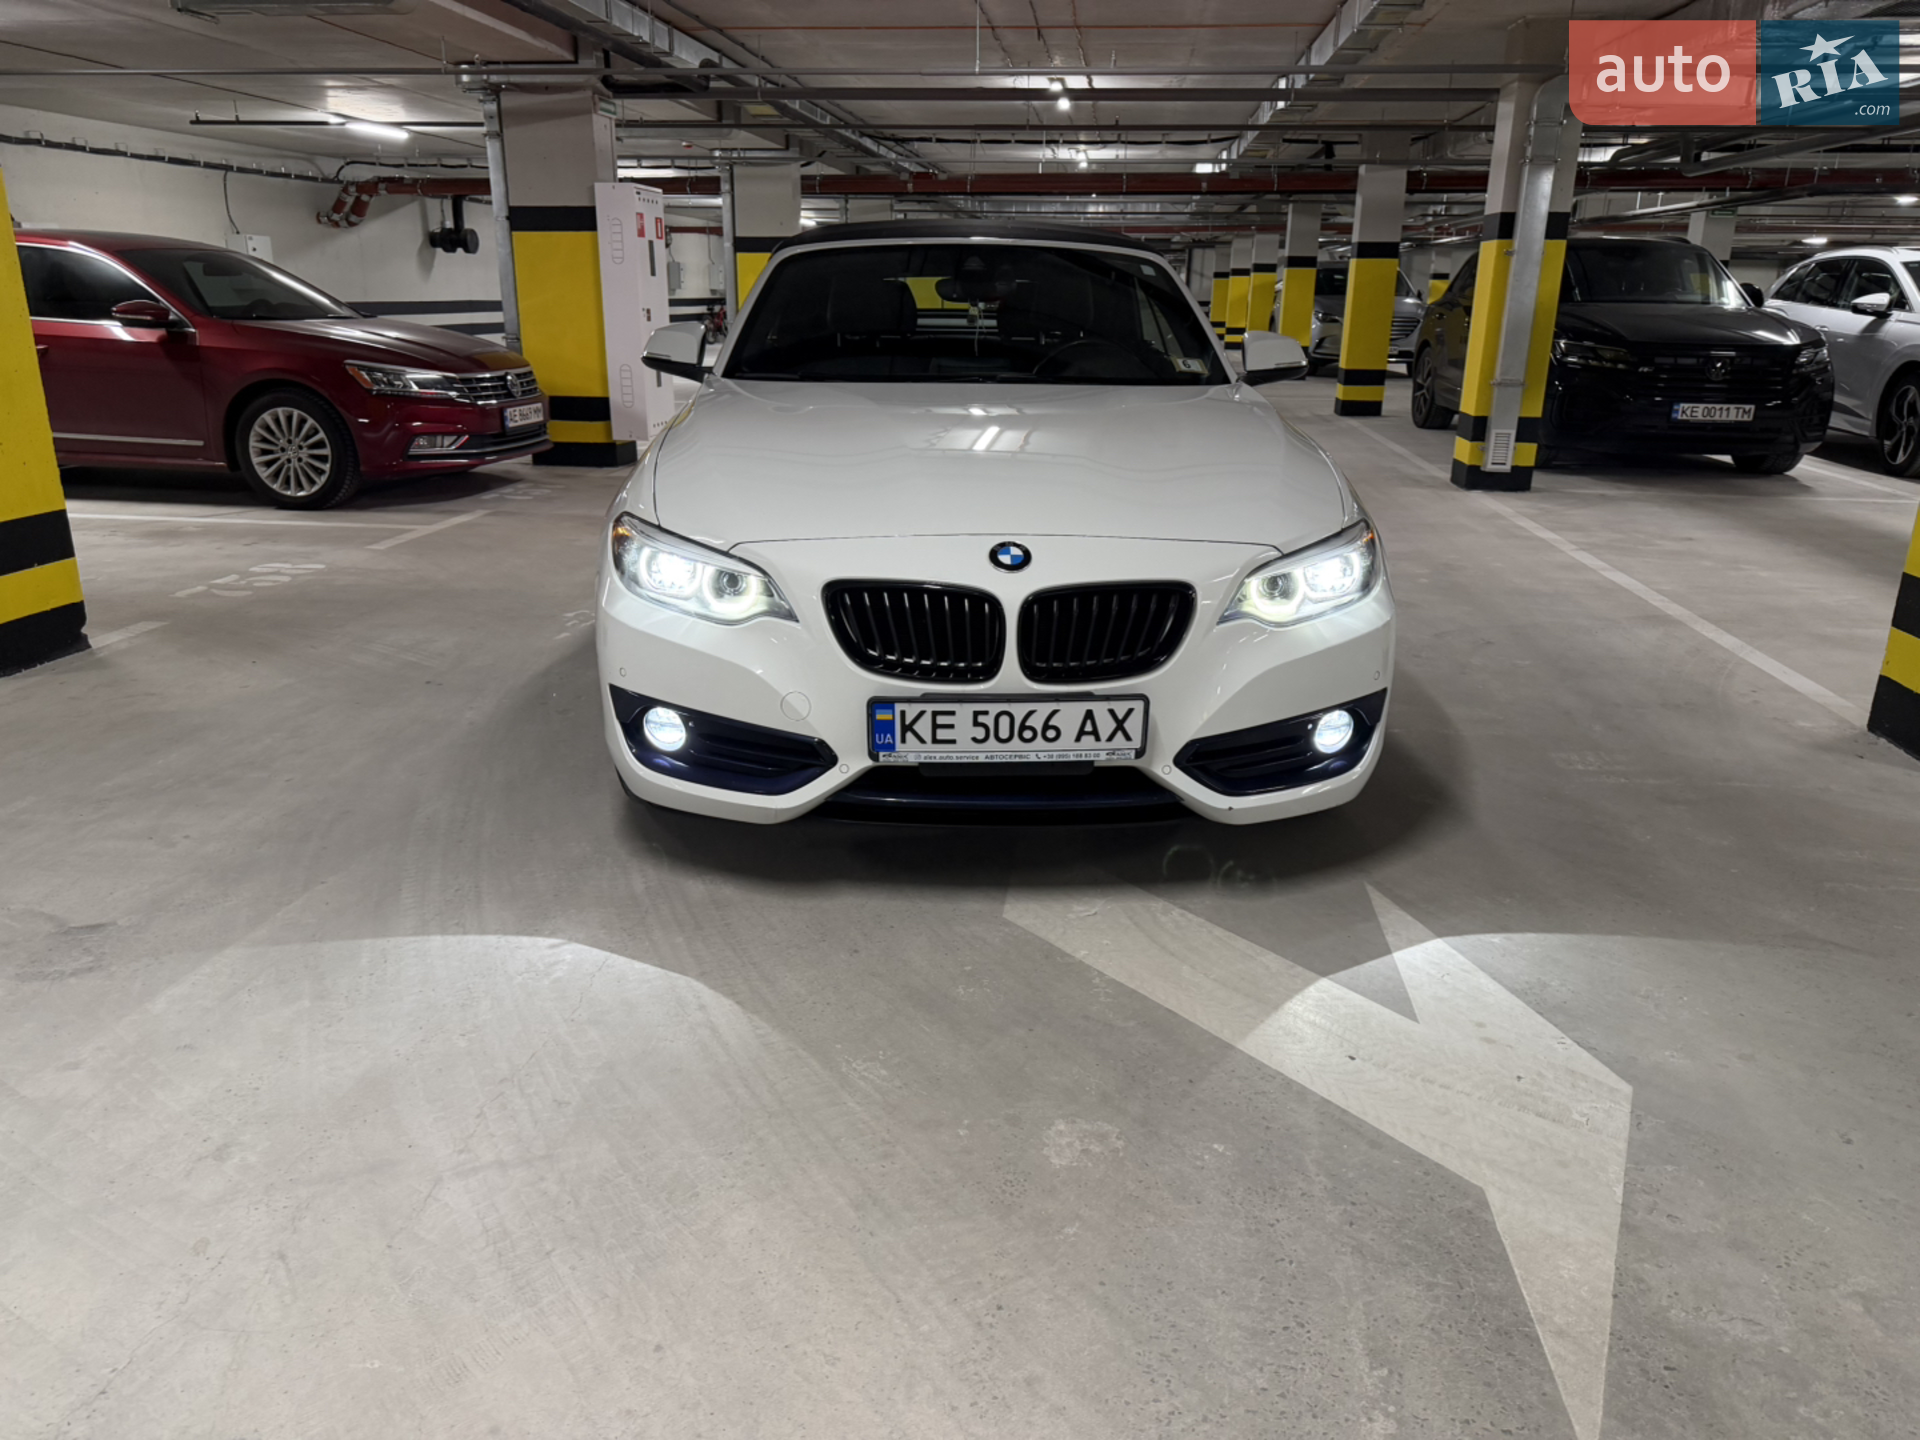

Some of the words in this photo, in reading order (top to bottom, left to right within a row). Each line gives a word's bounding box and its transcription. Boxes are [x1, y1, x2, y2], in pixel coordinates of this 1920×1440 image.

[1680, 405, 1700, 418] KE
[1702, 405, 1731, 419] 0011
[1733, 406, 1753, 419] TM
[900, 709, 957, 745] KE
[970, 708, 1062, 745] 5066
[1074, 707, 1136, 743] AX
[875, 733, 894, 745] UA
